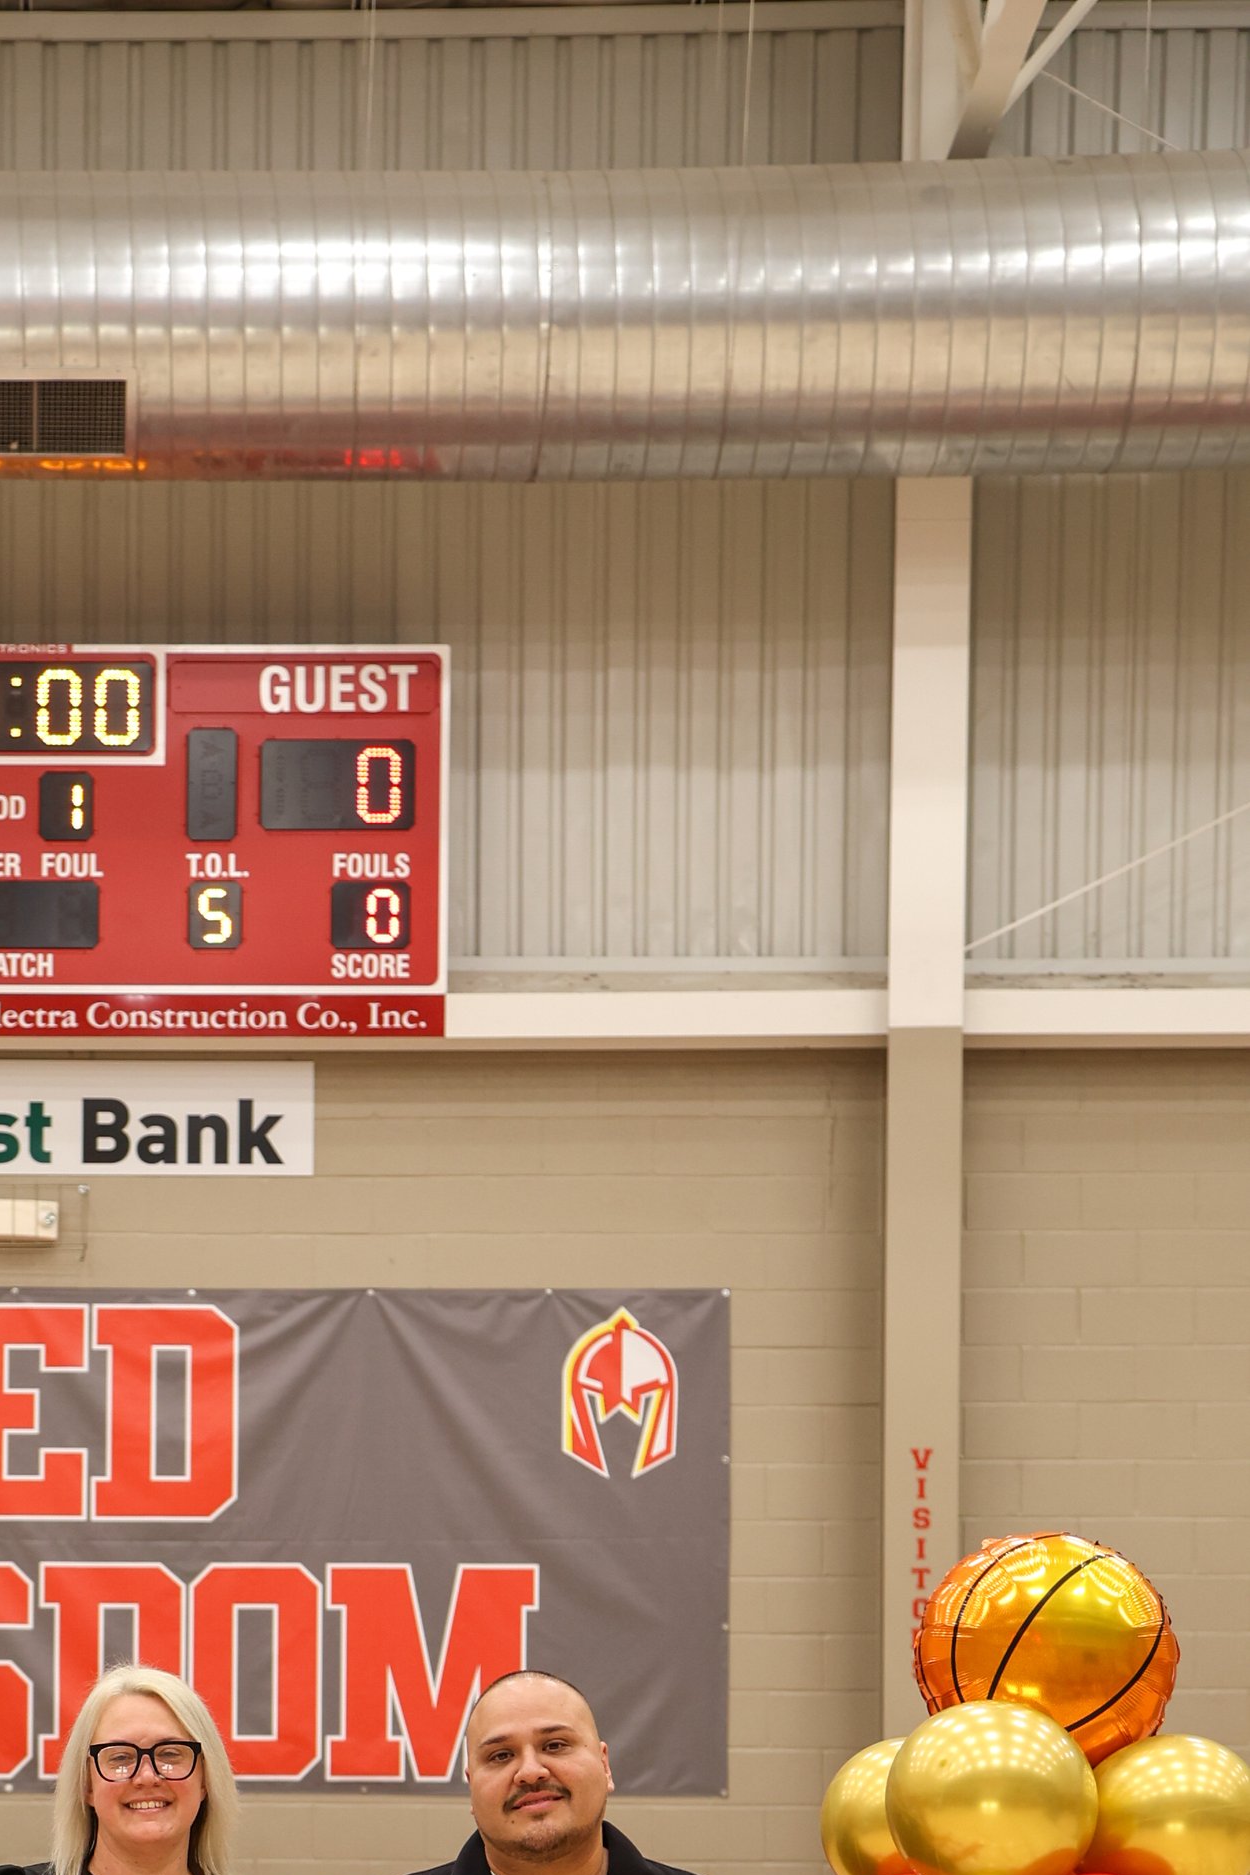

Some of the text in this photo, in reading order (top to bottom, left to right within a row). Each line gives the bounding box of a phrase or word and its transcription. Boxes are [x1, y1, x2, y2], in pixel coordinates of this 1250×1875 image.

[259, 664, 418, 714] GUEST
[71, 784, 84, 830] 1
[356, 746, 402, 824] 0
[41, 852, 104, 878] FOUL
[185, 852, 250, 879] T.O.L.
[332, 852, 411, 879] FOULS
[197, 888, 232, 944] 5
[365, 888, 400, 944] 0
[331, 953, 410, 979] SCORE
[86, 1001, 286, 1029] Construction
[296, 1002, 357, 1033] Co.,
[368, 1002, 427, 1029] Inc.
[82, 1098, 284, 1165] Bank
[910, 1447, 933, 1679] VISITO
